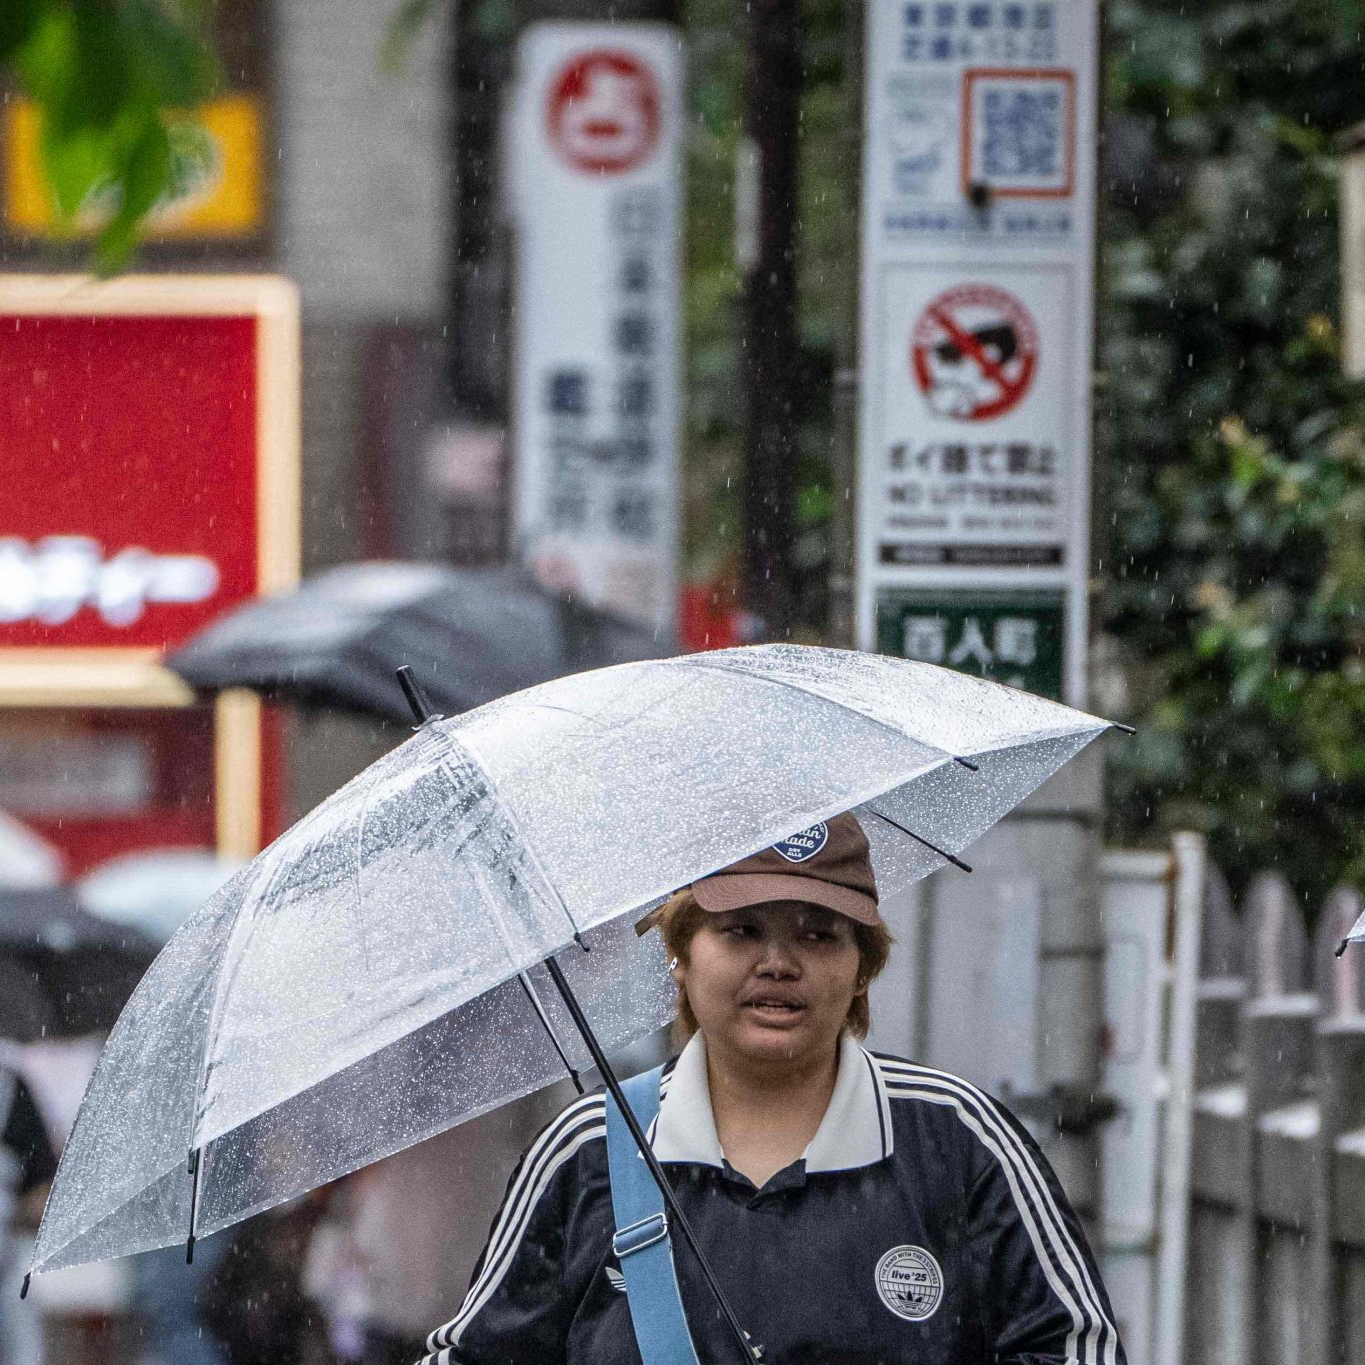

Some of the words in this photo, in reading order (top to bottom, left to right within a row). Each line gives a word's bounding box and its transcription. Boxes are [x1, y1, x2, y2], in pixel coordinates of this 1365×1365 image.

[890, 442, 1055, 475] ポイ捨て禁止
[890, 484, 923, 505] NO
[930, 482, 1055, 505] LITTERING
[903, 615, 1037, 665] 百人町
[891, 1270, 911, 1280] live
